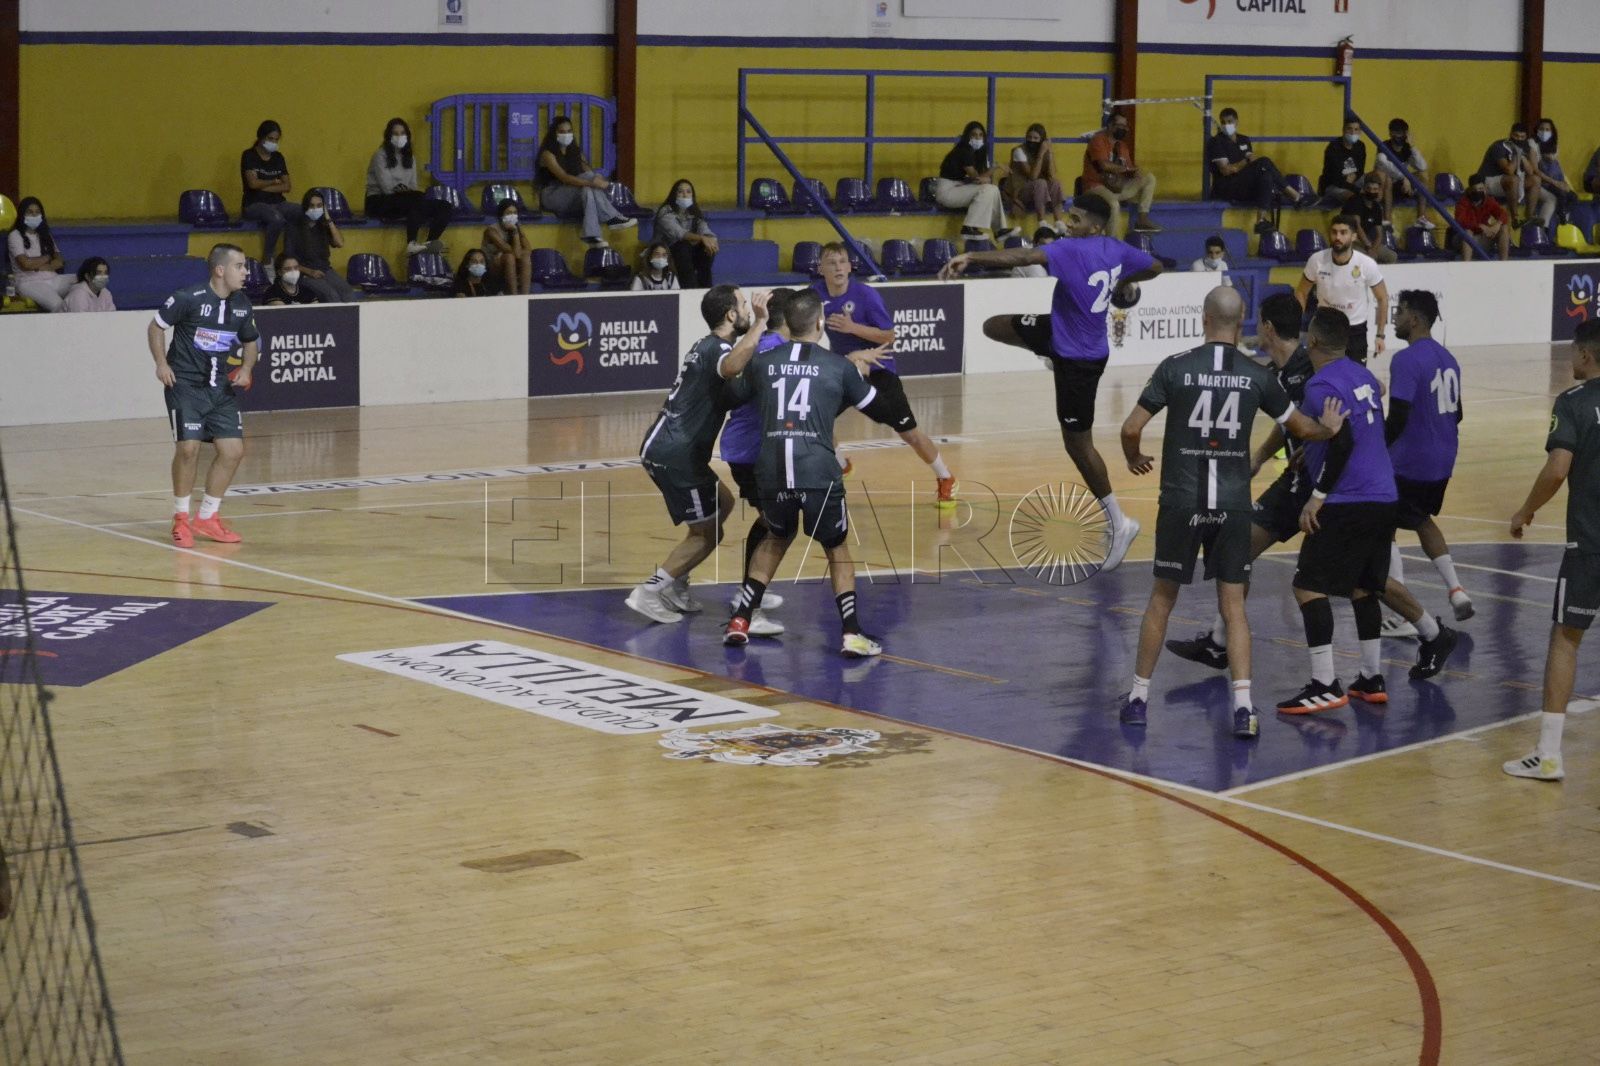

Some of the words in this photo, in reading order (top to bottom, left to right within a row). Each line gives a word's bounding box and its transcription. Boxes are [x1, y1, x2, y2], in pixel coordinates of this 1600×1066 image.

[1236, 0, 1306, 14] CAPITAL
[200, 303, 212, 317] 10
[893, 308, 945, 323] MELILLA
[1138, 306, 1167, 316] CIUDAD
[1169, 304, 1203, 315] AUTÓNO
[600, 320, 658, 335] MELILLA
[893, 323, 936, 338] SPORT
[1140, 318, 1205, 340] MELILL
[270, 333, 336, 350] MELILLA
[600, 335, 648, 351] SPORT
[893, 338, 945, 353] CAPITAL
[270, 350, 323, 367] SPORT
[600, 351, 658, 367] CAPITAL
[270, 366, 336, 383] CAPITAL
[768, 364, 777, 376] D.
[780, 364, 819, 377] VENTAS
[1184, 373, 1195, 386] D.
[1198, 373, 1252, 390] MARTINEZ
[771, 377, 811, 421] 14
[1430, 367, 1459, 415] 10
[1188, 389, 1242, 439] 44
[41, 601, 170, 640] CAPITAL
[430, 642, 748, 724] MELILLA
[537, 698, 660, 730] CIUDAD
